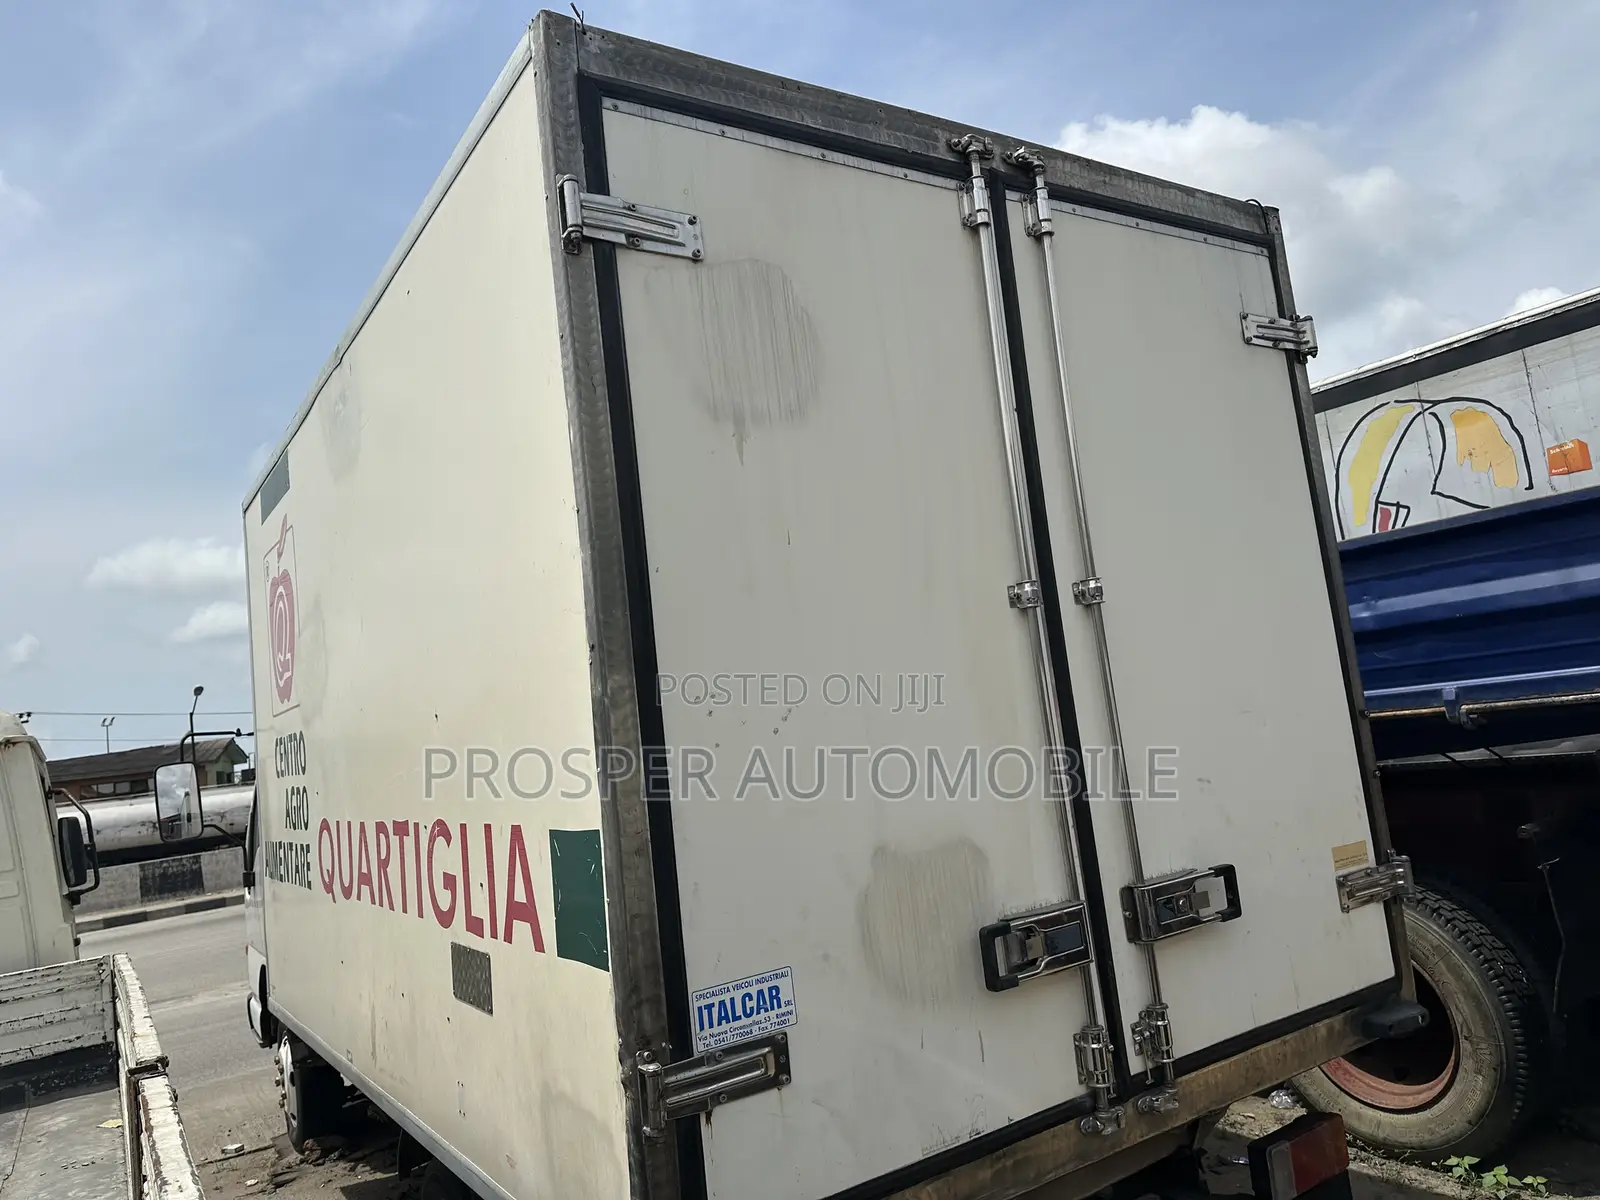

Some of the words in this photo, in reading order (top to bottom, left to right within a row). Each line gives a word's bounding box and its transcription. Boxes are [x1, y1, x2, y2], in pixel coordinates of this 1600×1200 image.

[274, 730, 307, 779] CENTRO
[285, 785, 309, 831] AGRO
[317, 817, 546, 954] QUARTIGLIA
[695, 987, 731, 1002] SPECIALISTA
[732, 980, 754, 992] VEICOLI
[755, 971, 789, 985] INDUSTRIALI
[697, 985, 782, 1032] ITALCAR
[784, 1000, 793, 1008] SRL
[709, 1030, 728, 1040] Nuova
[776, 1010, 794, 1020] RIMINI
[758, 1025, 769, 1033] Fax
[769, 1018, 790, 1030] 774001
